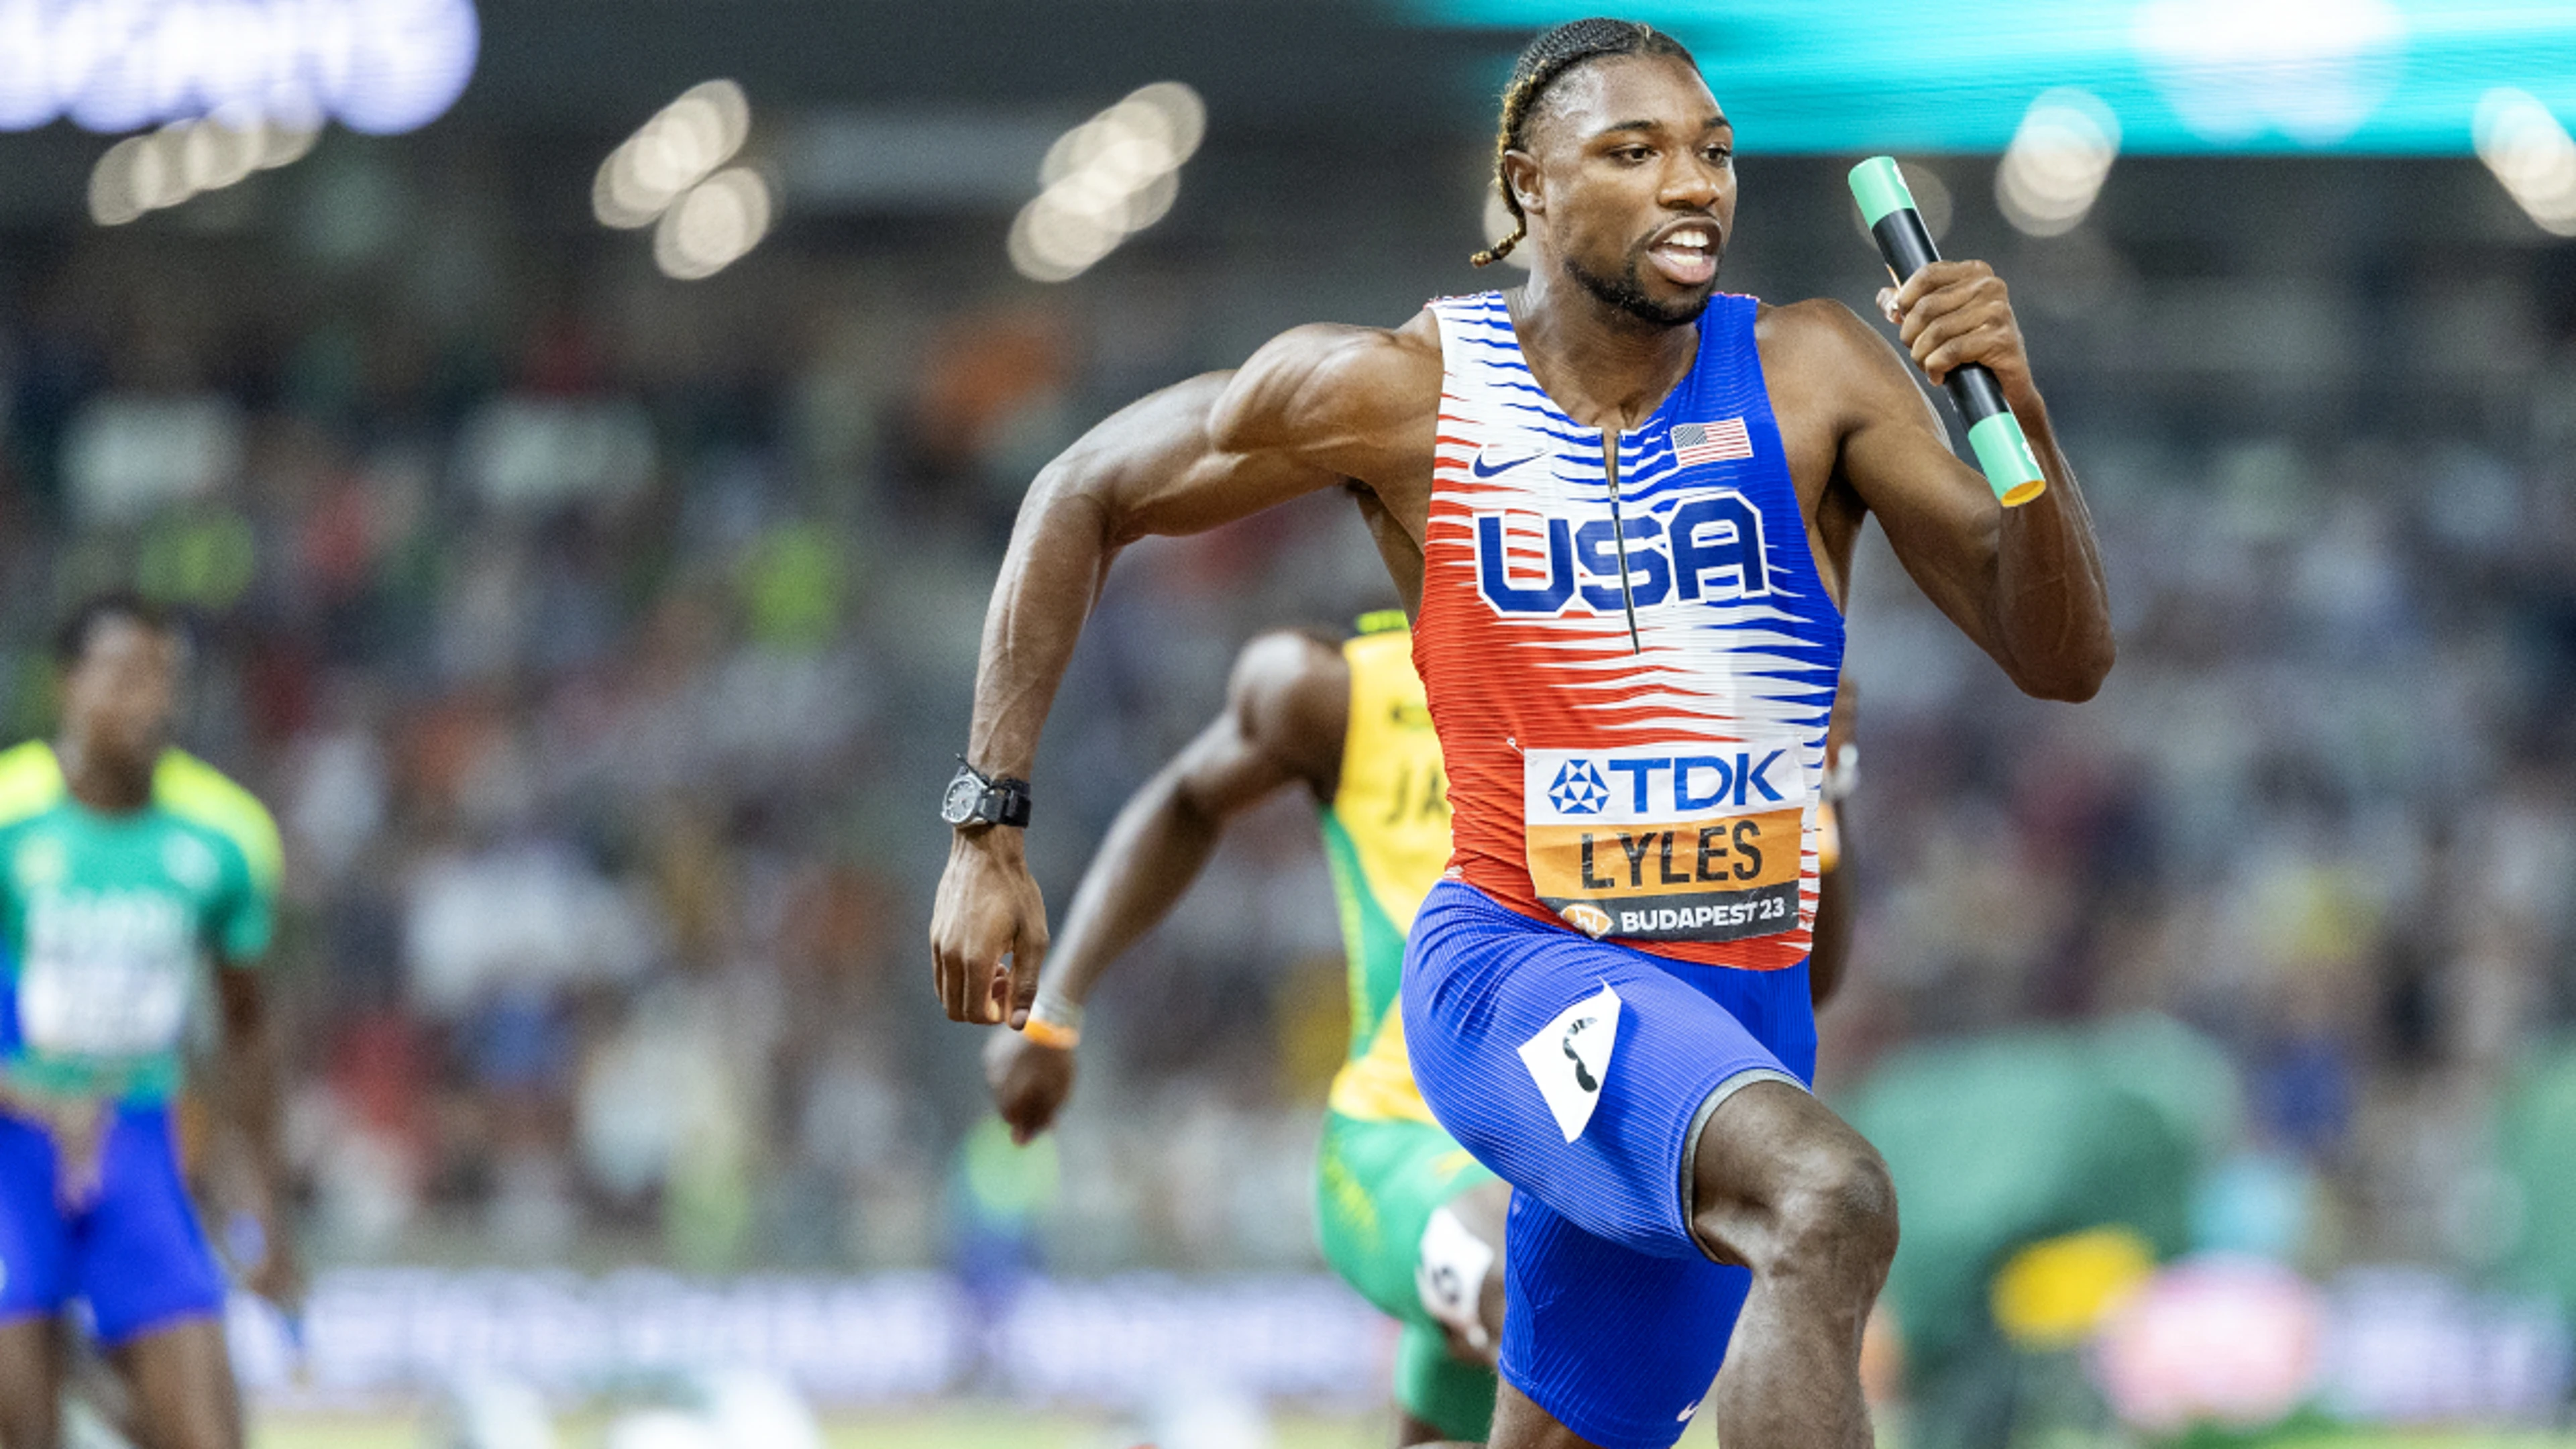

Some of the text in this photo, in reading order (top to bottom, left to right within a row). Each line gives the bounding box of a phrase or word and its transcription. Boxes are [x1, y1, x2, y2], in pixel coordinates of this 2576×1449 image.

[1473, 491, 1770, 617] USA
[1609, 749, 1786, 813] TDK
[1581, 820, 1762, 889] LYLES
[1621, 898, 1785, 932] BUDAPEST 23
